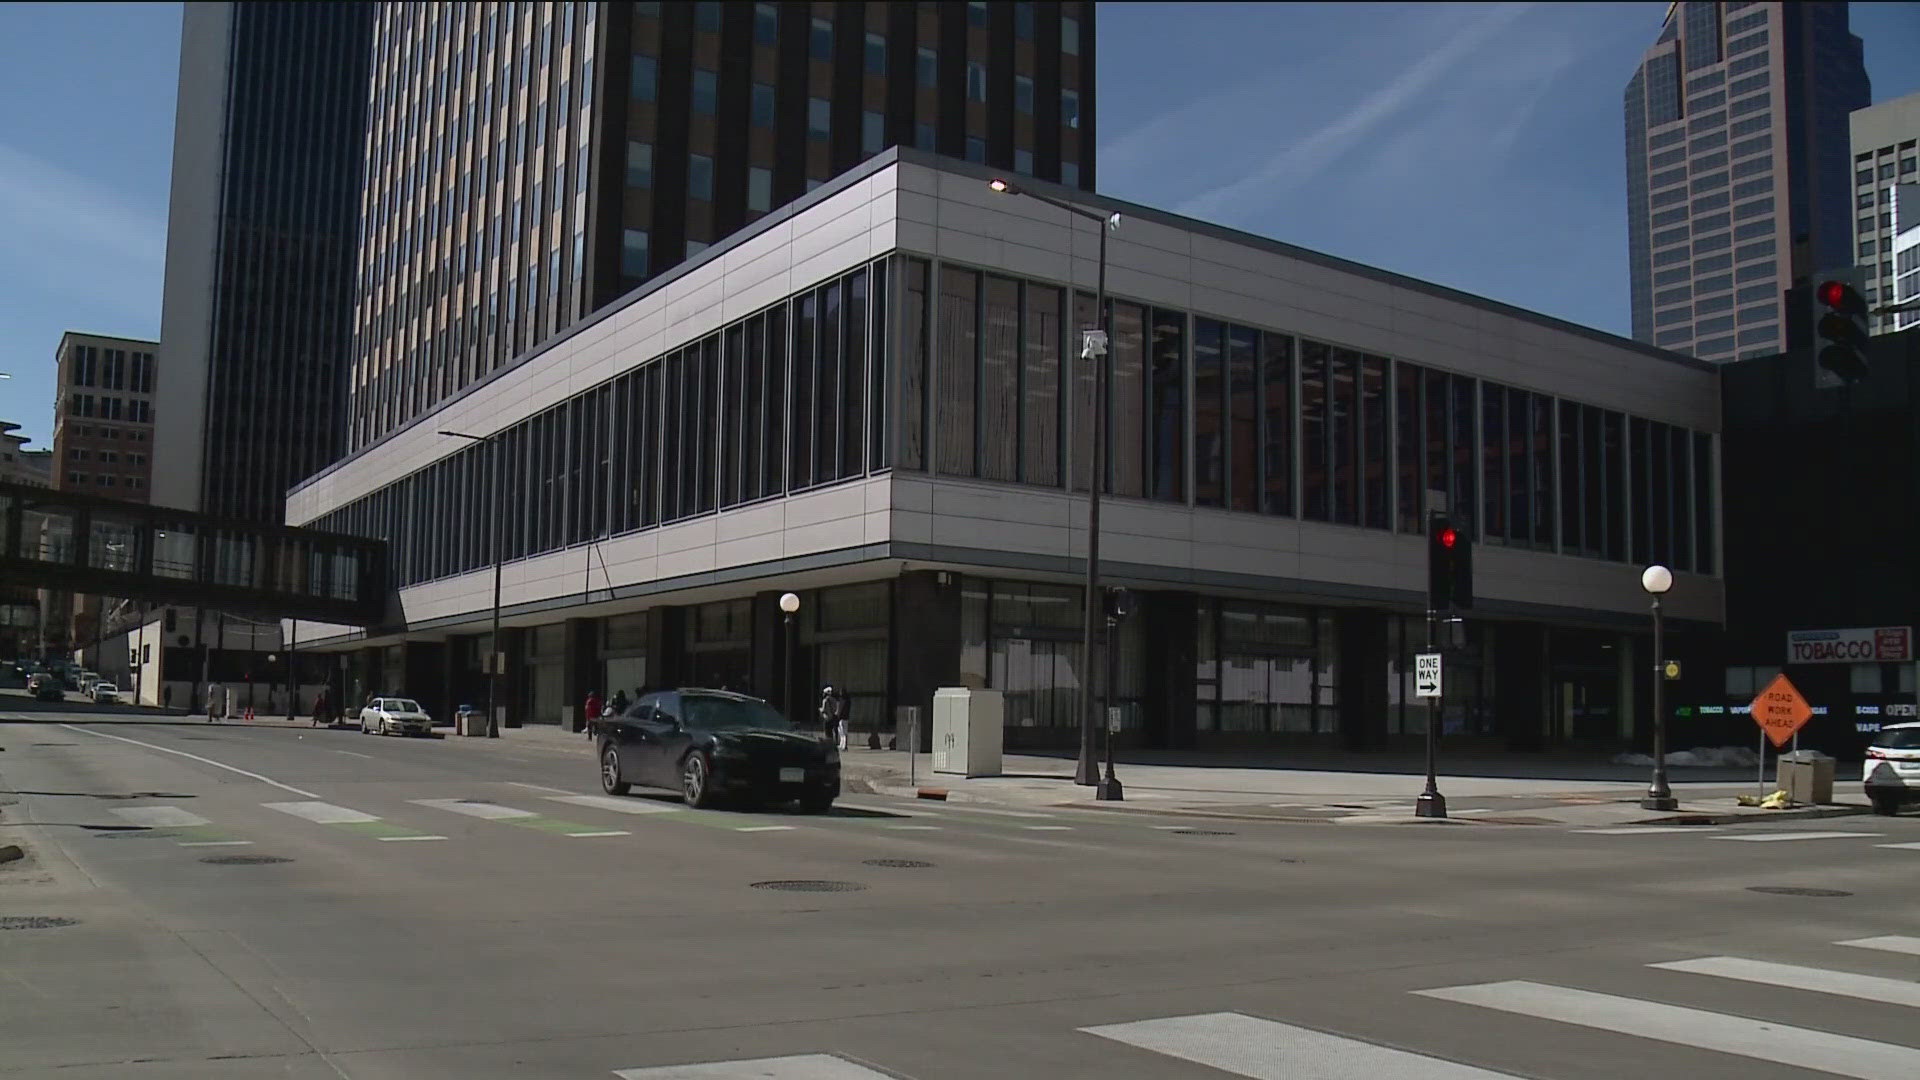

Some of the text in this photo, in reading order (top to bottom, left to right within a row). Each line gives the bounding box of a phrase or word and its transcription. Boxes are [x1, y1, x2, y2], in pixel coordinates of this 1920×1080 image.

[1792, 640, 1873, 660] TOBACCO
[1419, 658, 1438, 669] ONE
[1418, 670, 1439, 680] WAY
[1768, 692, 1793, 702] ROAD
[1767, 706, 1793, 715] WORK
[1886, 704, 1918, 717] OPEN
[1765, 718, 1793, 728] AHEAD
[1856, 723, 1881, 733] VAPE
